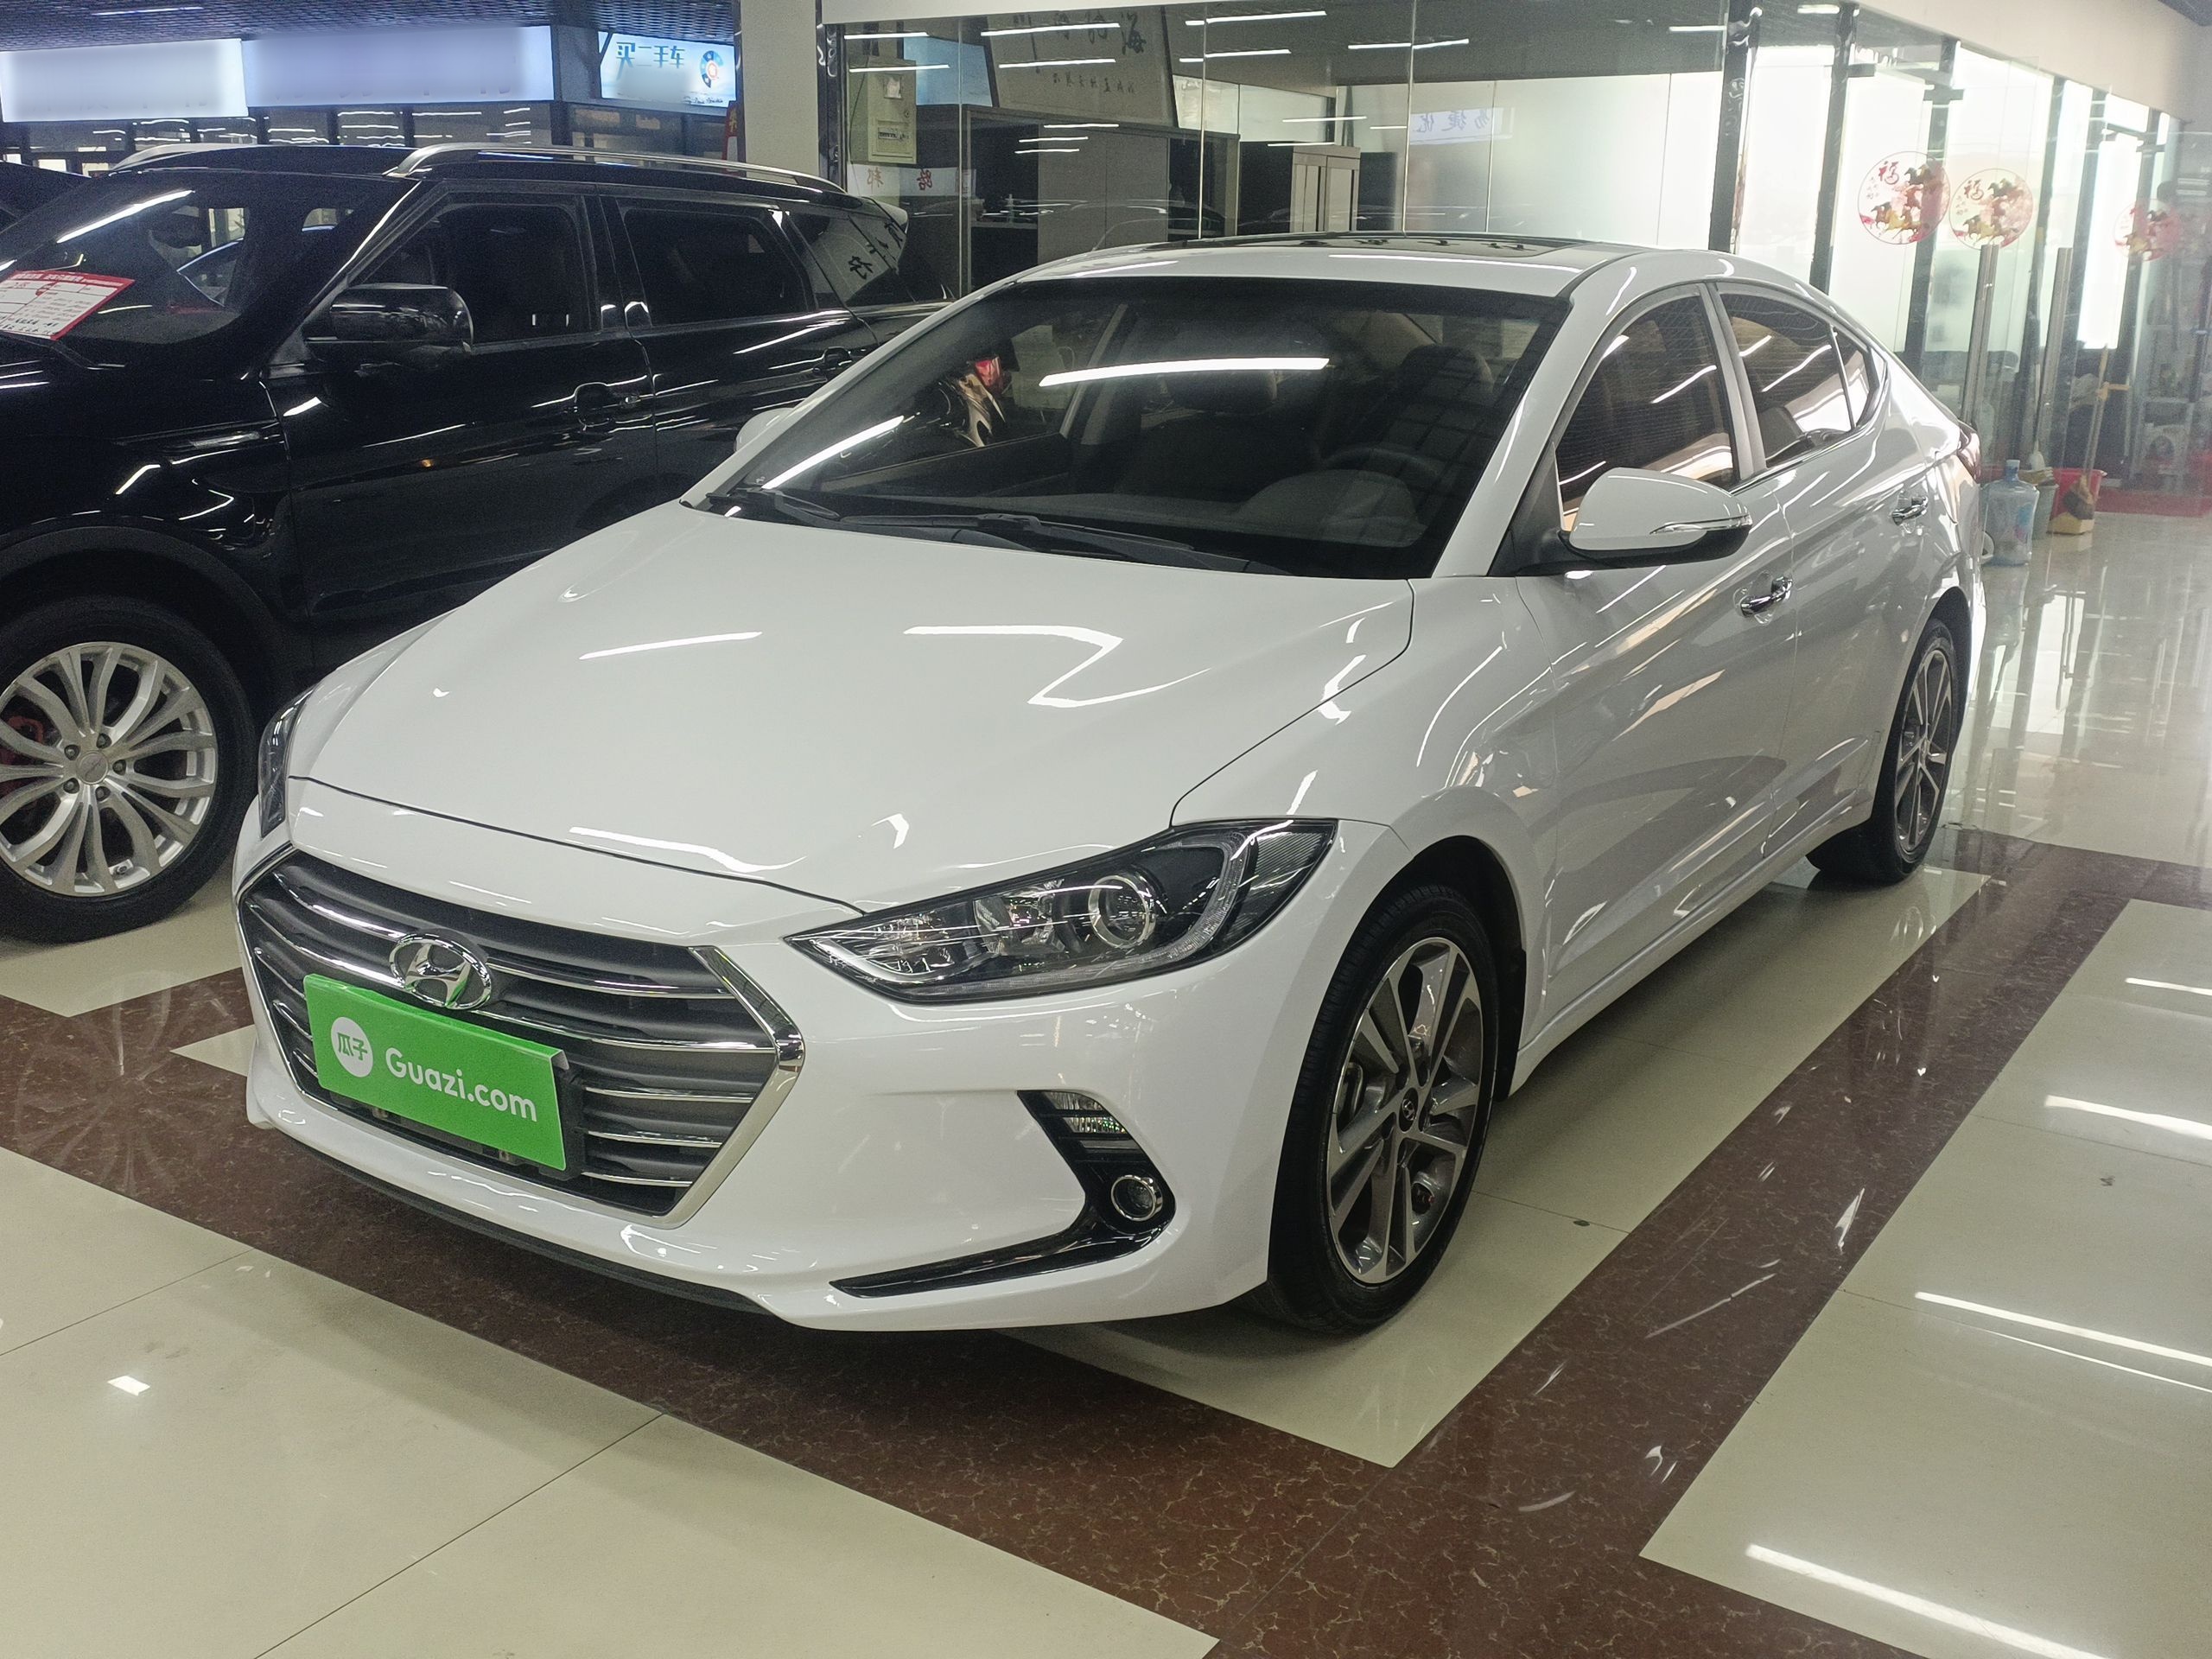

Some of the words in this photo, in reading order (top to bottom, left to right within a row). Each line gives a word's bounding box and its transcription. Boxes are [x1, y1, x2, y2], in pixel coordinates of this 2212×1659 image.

[615, 41, 686, 76] 买二手车
[1878, 161, 1899, 184] 福
[1963, 179, 1985, 200] 福
[337, 1032, 368, 1060] 瓜子
[385, 1047, 537, 1122] Guazi.com
